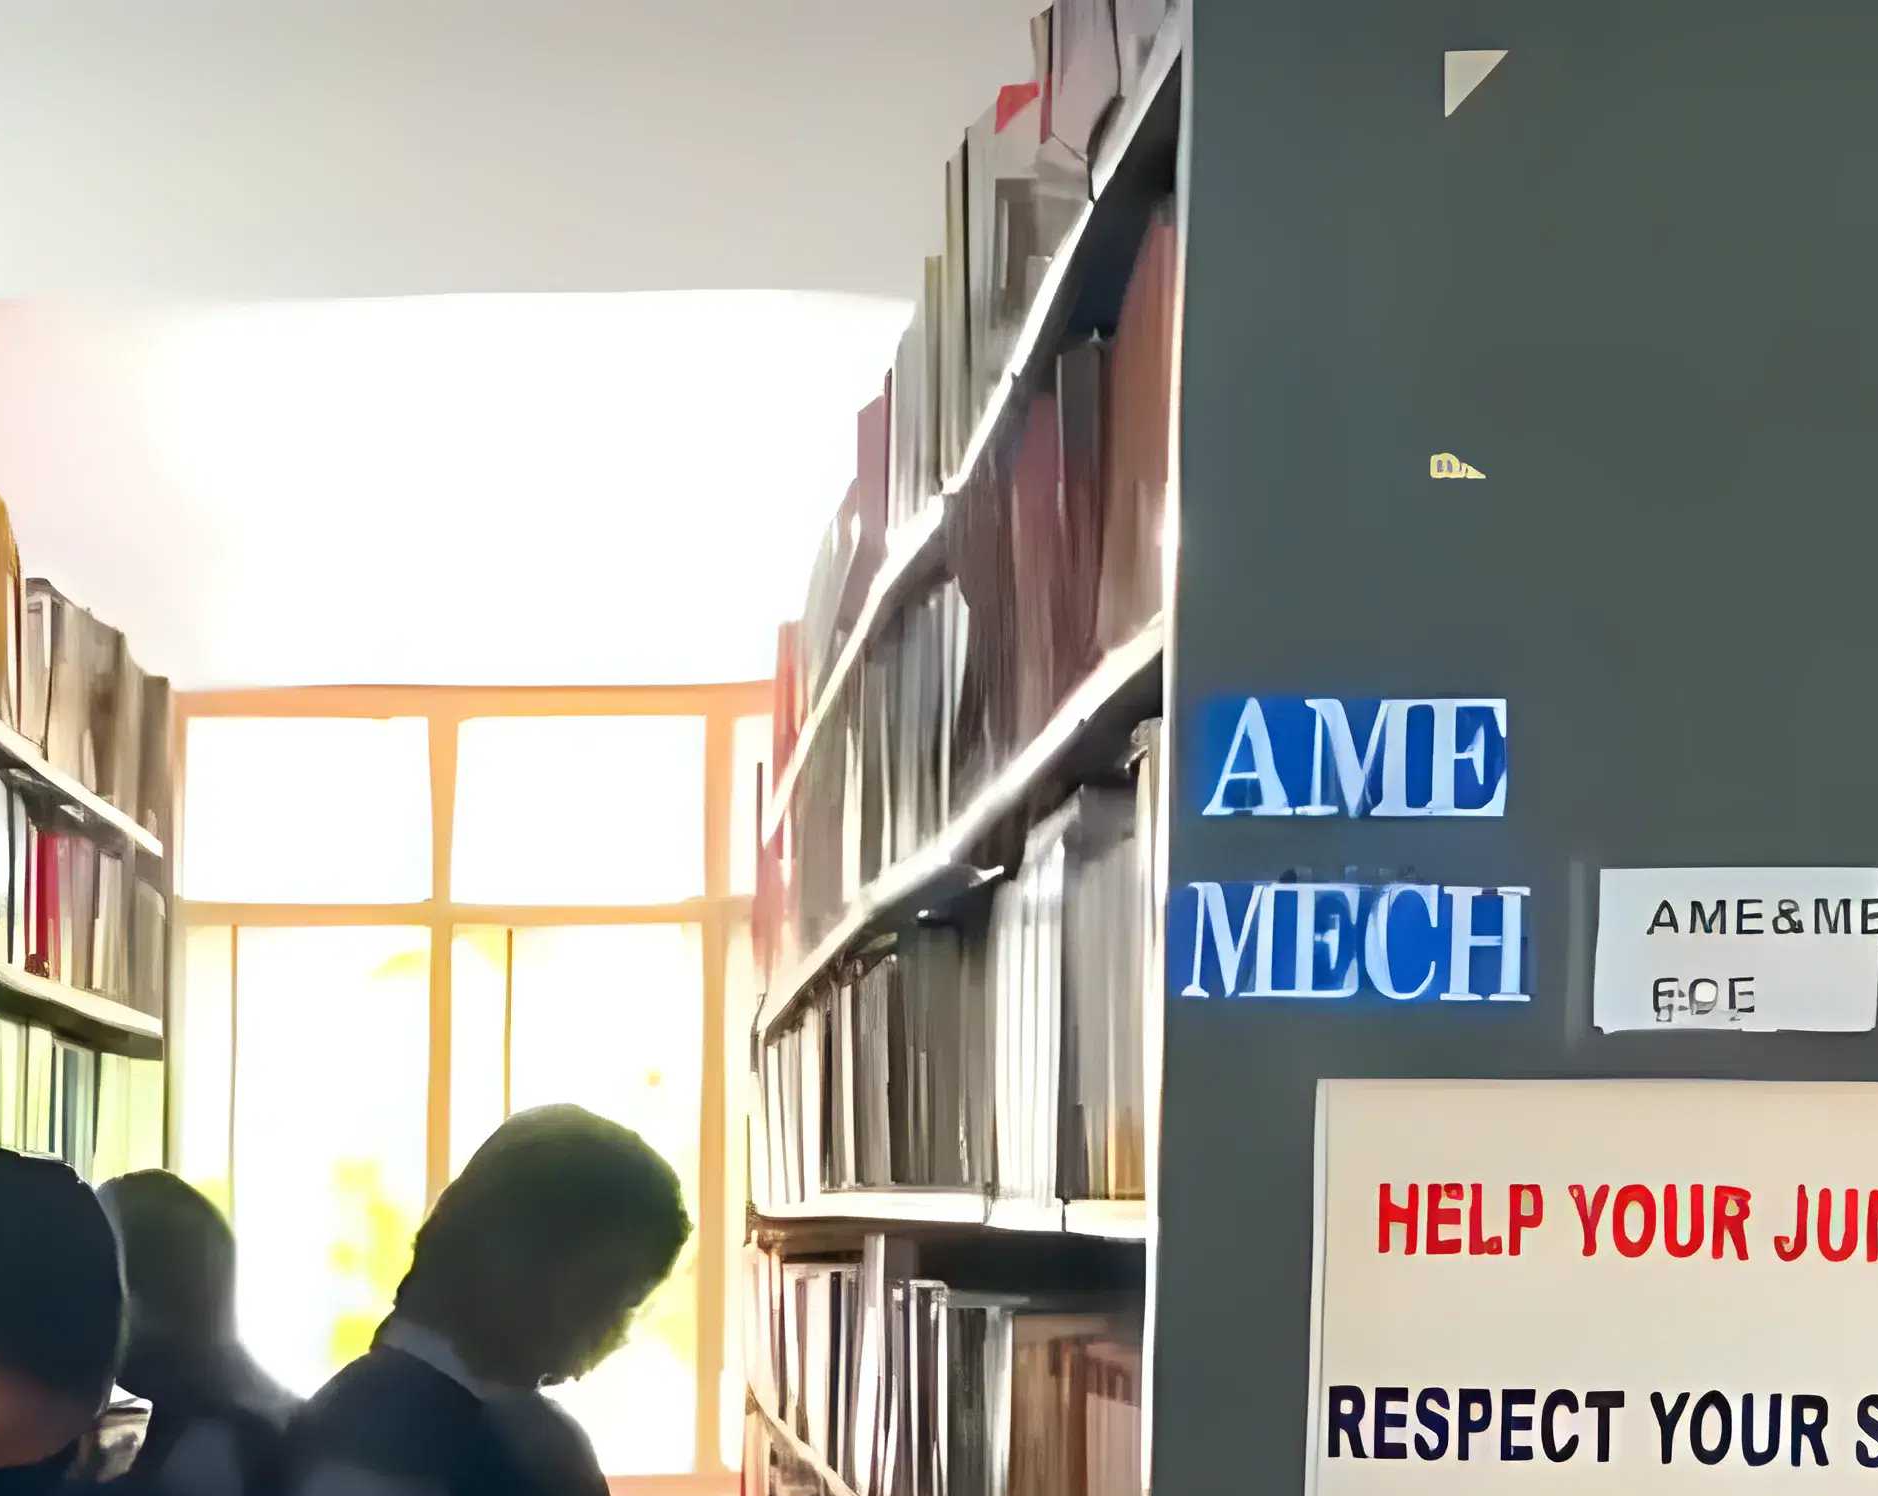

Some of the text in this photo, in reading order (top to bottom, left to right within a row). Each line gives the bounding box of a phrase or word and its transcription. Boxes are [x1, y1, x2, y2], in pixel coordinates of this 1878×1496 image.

[1201, 697, 1508, 818] AME
[1180, 880, 1532, 1002] MECH
[1377, 1182, 1544, 1257] HELP
[1567, 1183, 1752, 1262] YOUR
[1326, 1384, 1626, 1464] RESPECT
[1648, 1389, 1830, 1467] YOUR
